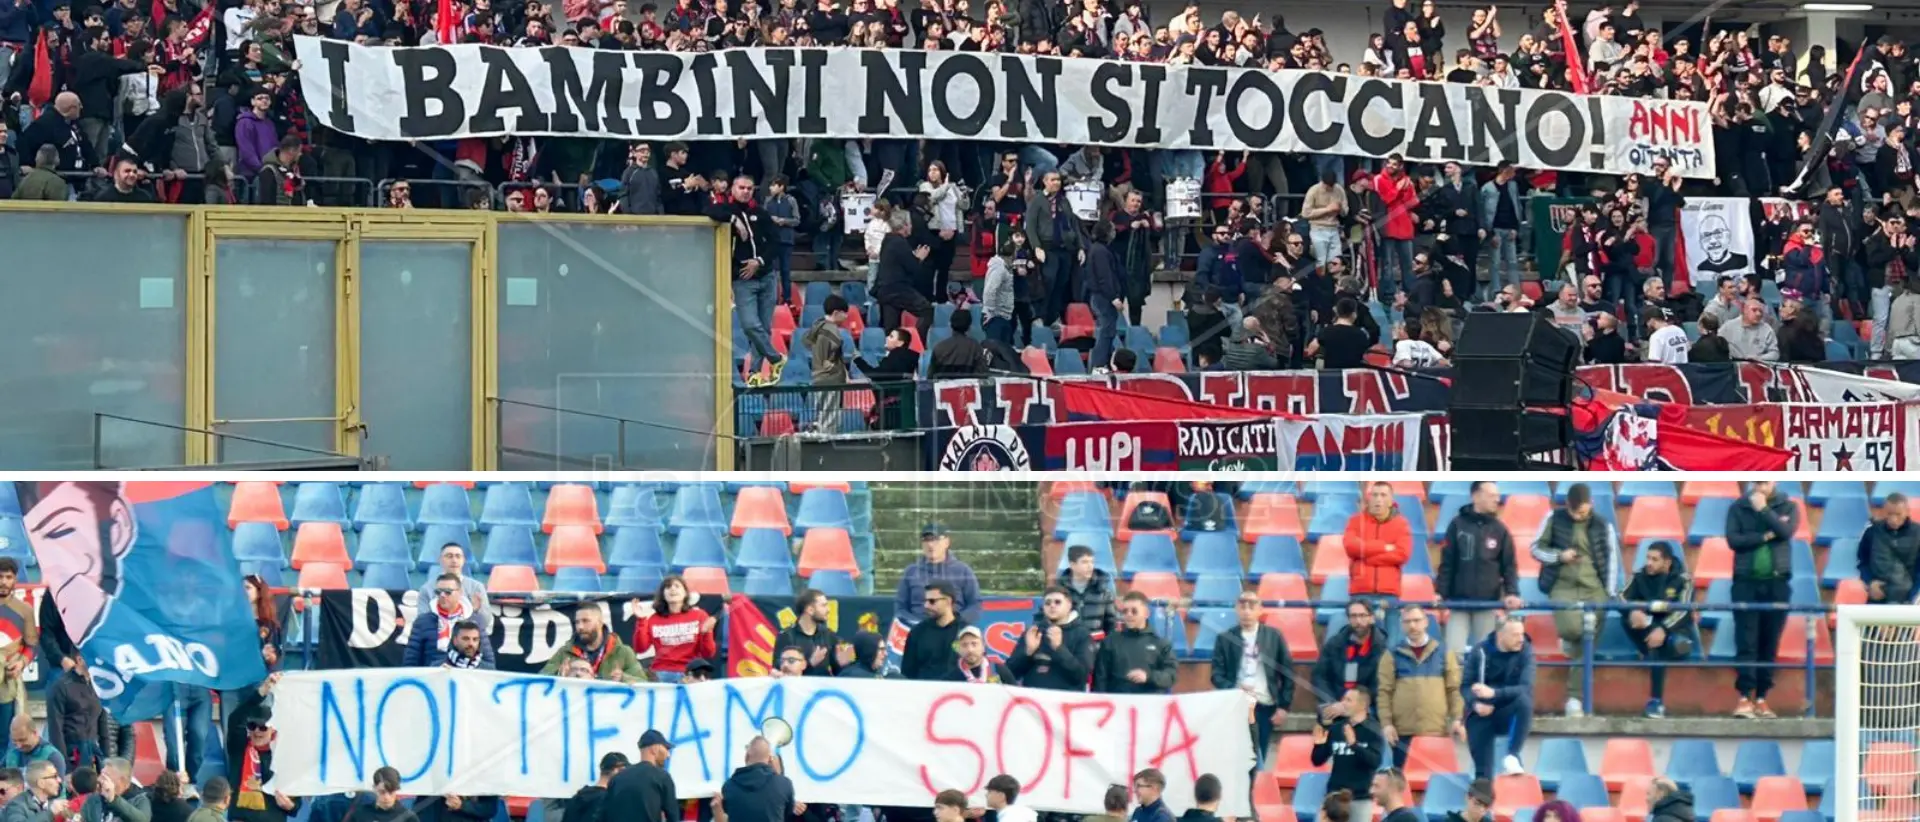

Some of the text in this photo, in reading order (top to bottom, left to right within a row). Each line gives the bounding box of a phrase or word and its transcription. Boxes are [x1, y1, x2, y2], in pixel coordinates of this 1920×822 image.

[321, 44, 1604, 168] I BAMBINI NON SI TOCCANO!
[1629, 101, 1701, 145] ANNI
[1178, 423, 1275, 457] RADICATI
[1788, 404, 1893, 439] ARMATA
[1066, 432, 1141, 471] LUPI
[1865, 442, 1893, 471] 92
[319, 678, 1199, 800] NOI TIFIAMO SOFIA
